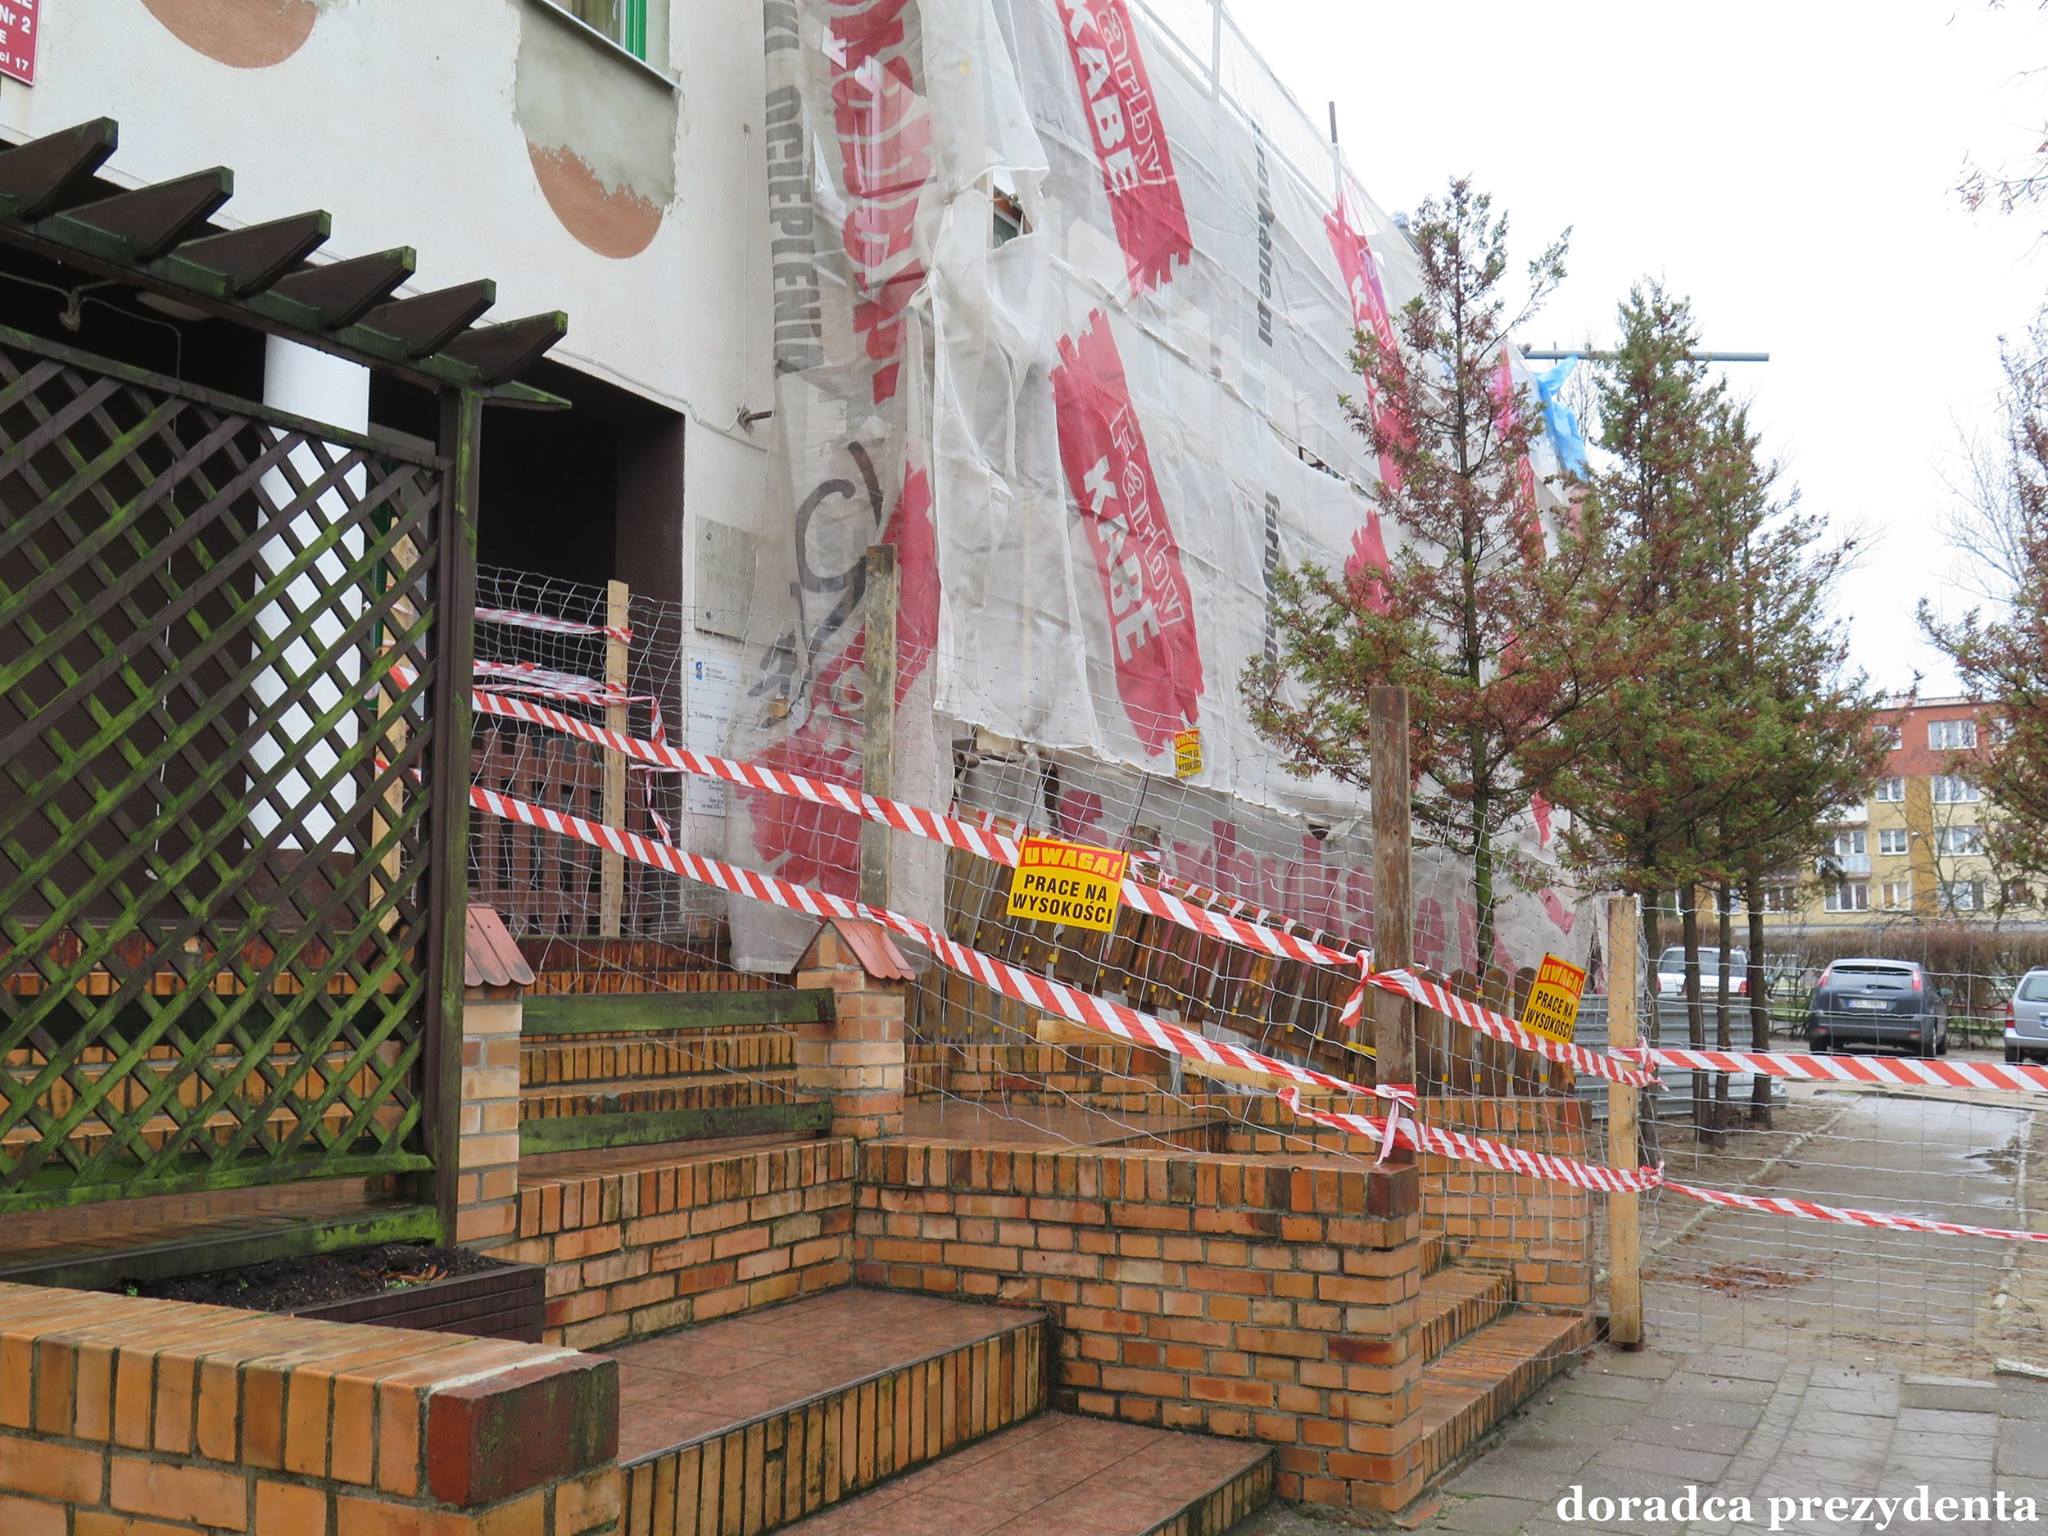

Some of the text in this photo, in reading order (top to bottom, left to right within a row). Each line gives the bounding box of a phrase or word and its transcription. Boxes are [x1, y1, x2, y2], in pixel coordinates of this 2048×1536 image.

[21, 16, 31, 35] 2
[16, 57, 29, 72] 17
[1062, 0, 1139, 197] KABE
[1098, 0, 1167, 184] arby
[1109, 403, 1186, 628] Farby
[1083, 454, 1161, 663] KABE
[1024, 846, 1121, 878] UWAGA!
[1023, 873, 1107, 902] PRACE NA
[1012, 892, 1113, 924] WYSOKOŚCI
[1535, 989, 1574, 1019] PRACE NA
